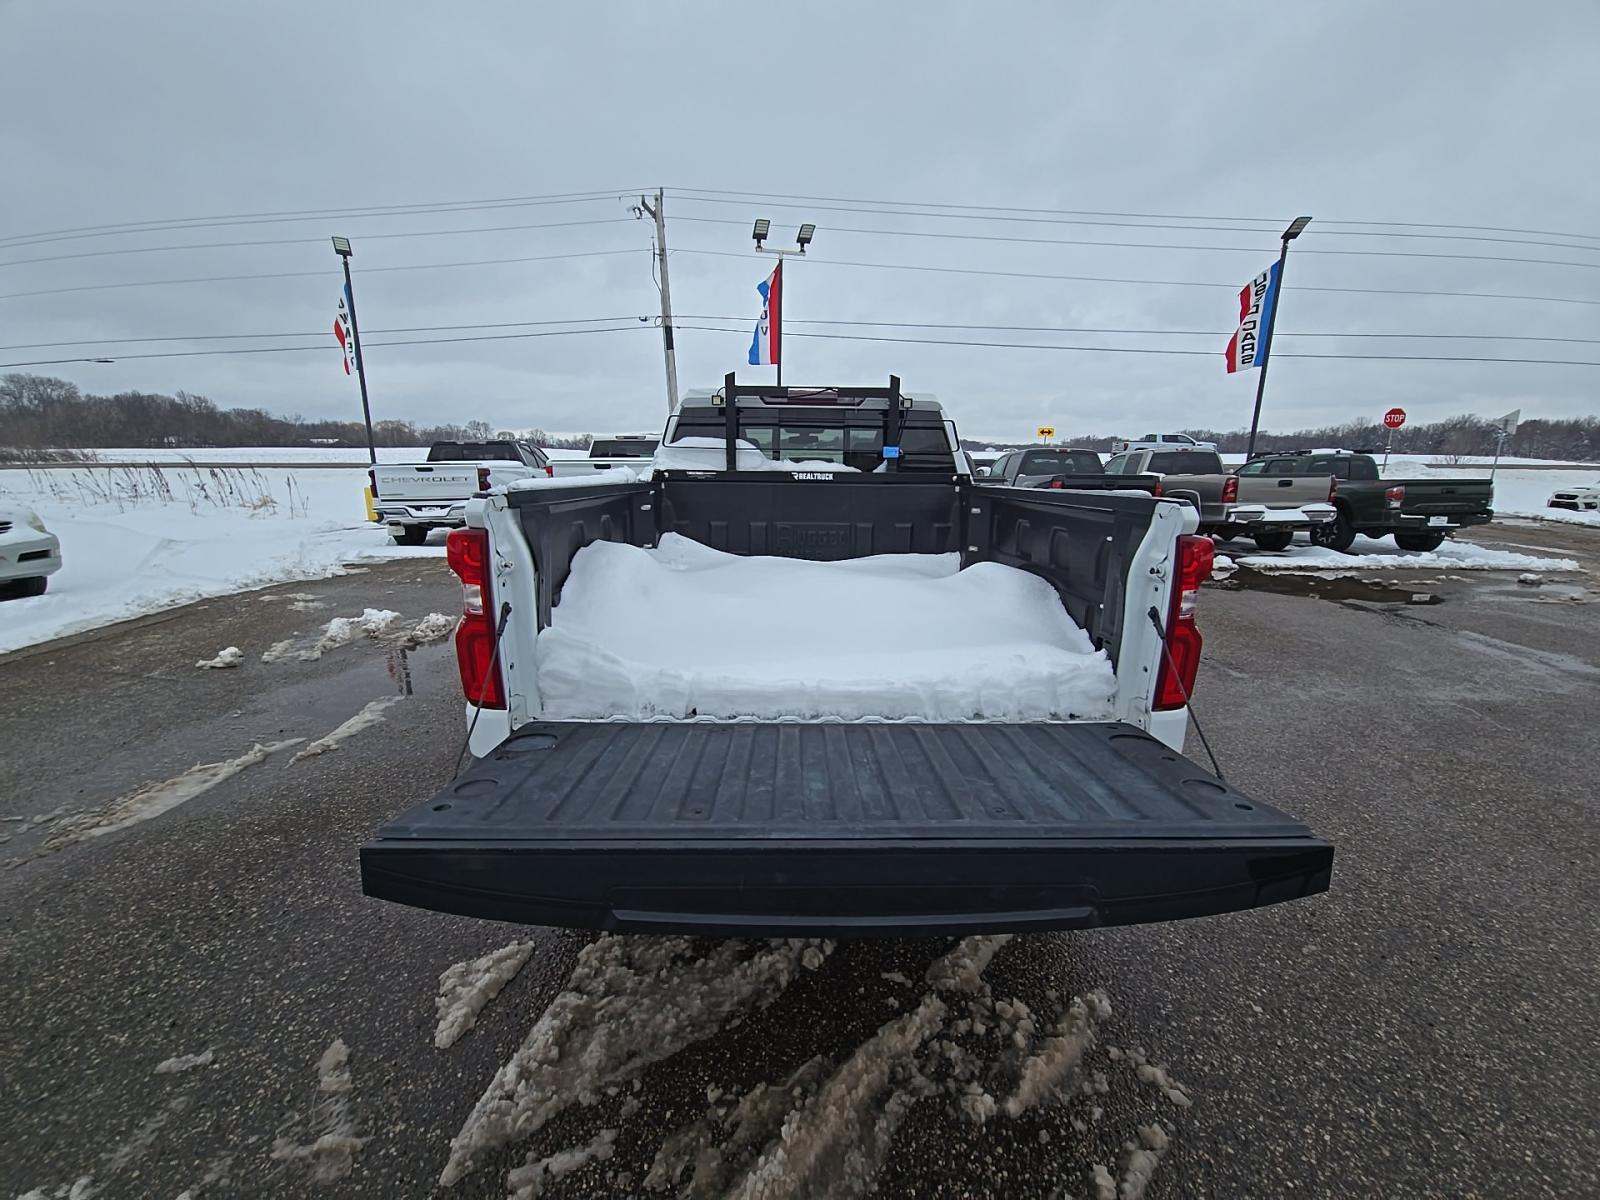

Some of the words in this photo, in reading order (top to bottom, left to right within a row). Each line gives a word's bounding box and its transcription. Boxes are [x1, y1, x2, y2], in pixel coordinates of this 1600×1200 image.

[1386, 414, 1405, 423] STOP
[381, 476, 470, 484] CHEVROLET
[798, 472, 834, 481] REALTRUCK
